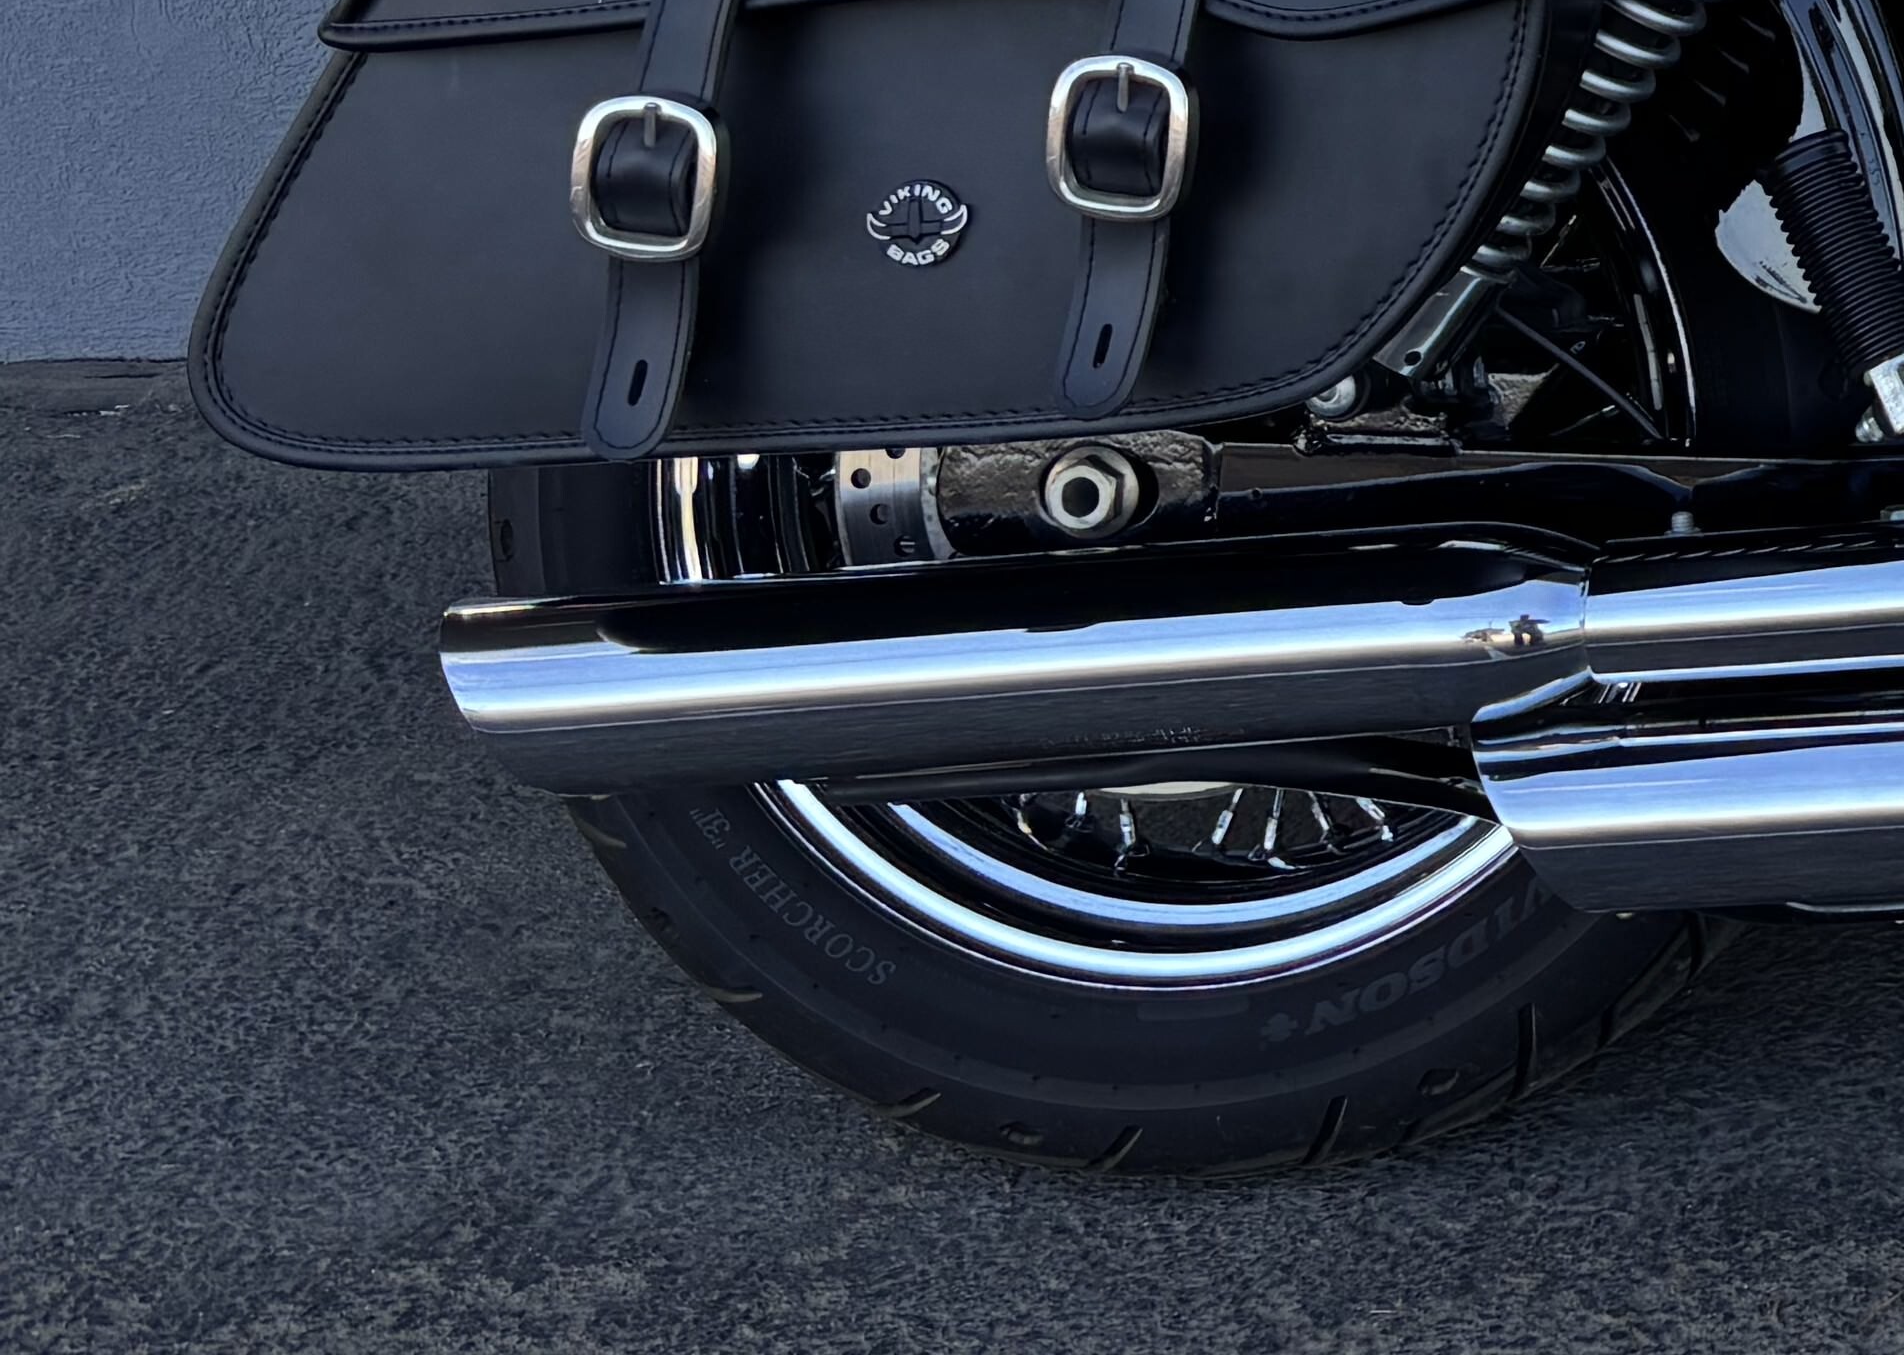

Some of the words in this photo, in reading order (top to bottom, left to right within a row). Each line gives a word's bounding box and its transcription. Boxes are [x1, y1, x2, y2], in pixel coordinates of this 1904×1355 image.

[878, 184, 953, 216] VIKING
[886, 238, 950, 266] BAGS
[729, 845, 897, 985] SCORCHER
